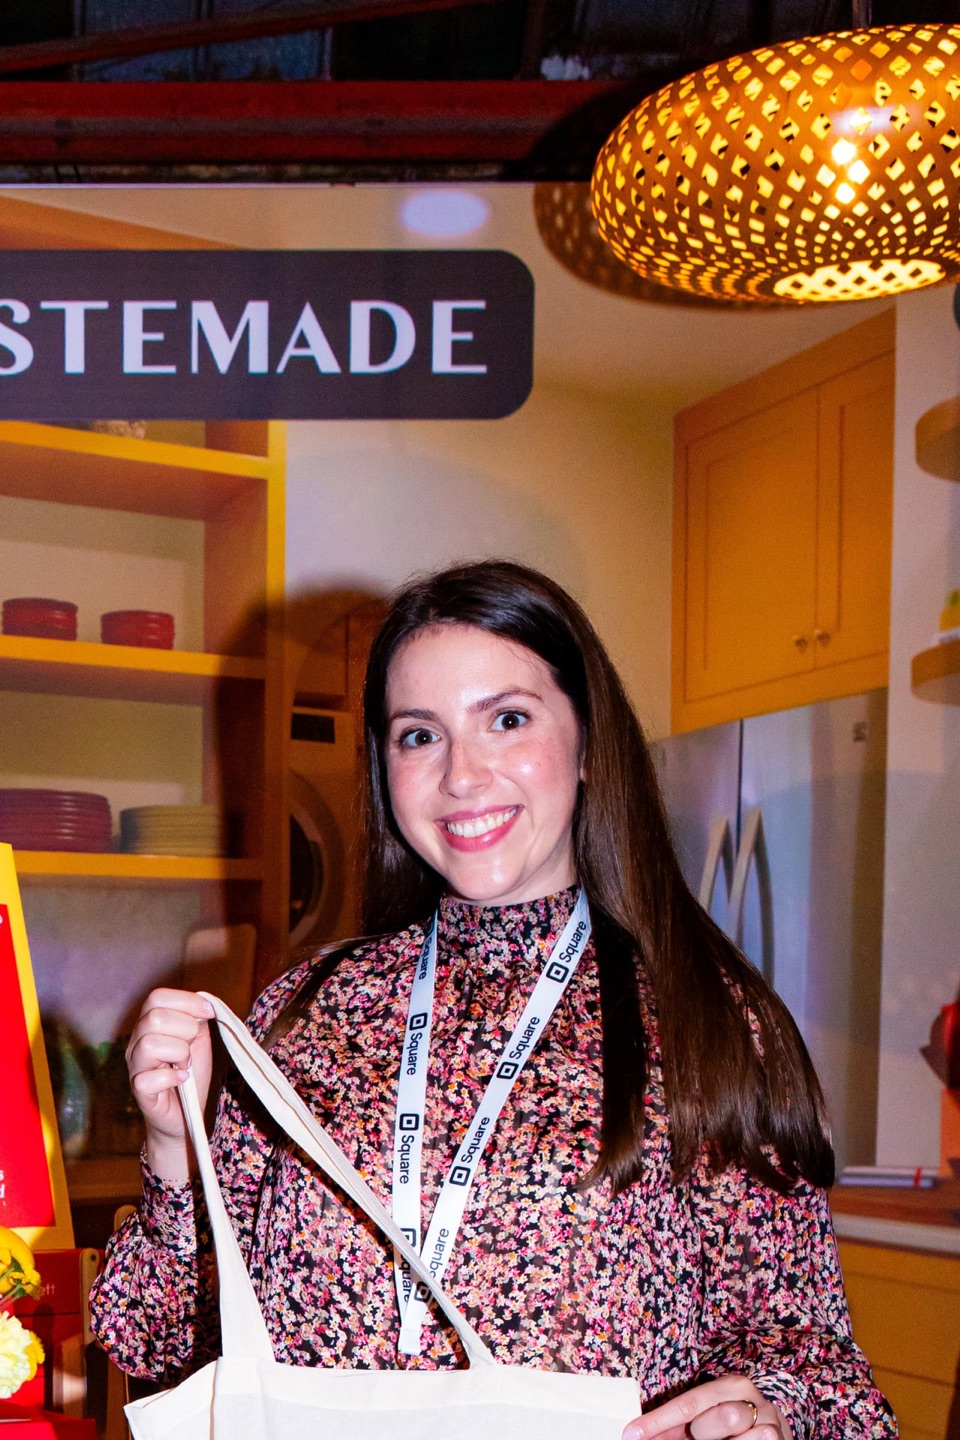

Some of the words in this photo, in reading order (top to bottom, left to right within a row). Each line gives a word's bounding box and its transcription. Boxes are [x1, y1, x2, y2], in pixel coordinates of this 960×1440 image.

[559, 920, 587, 964] Square
[406, 1032, 422, 1076] Square
[509, 1016, 541, 1060] Square
[398, 1134, 414, 1184] Square
[461, 1116, 490, 1164] Square
[399, 1256, 411, 1303] quare
